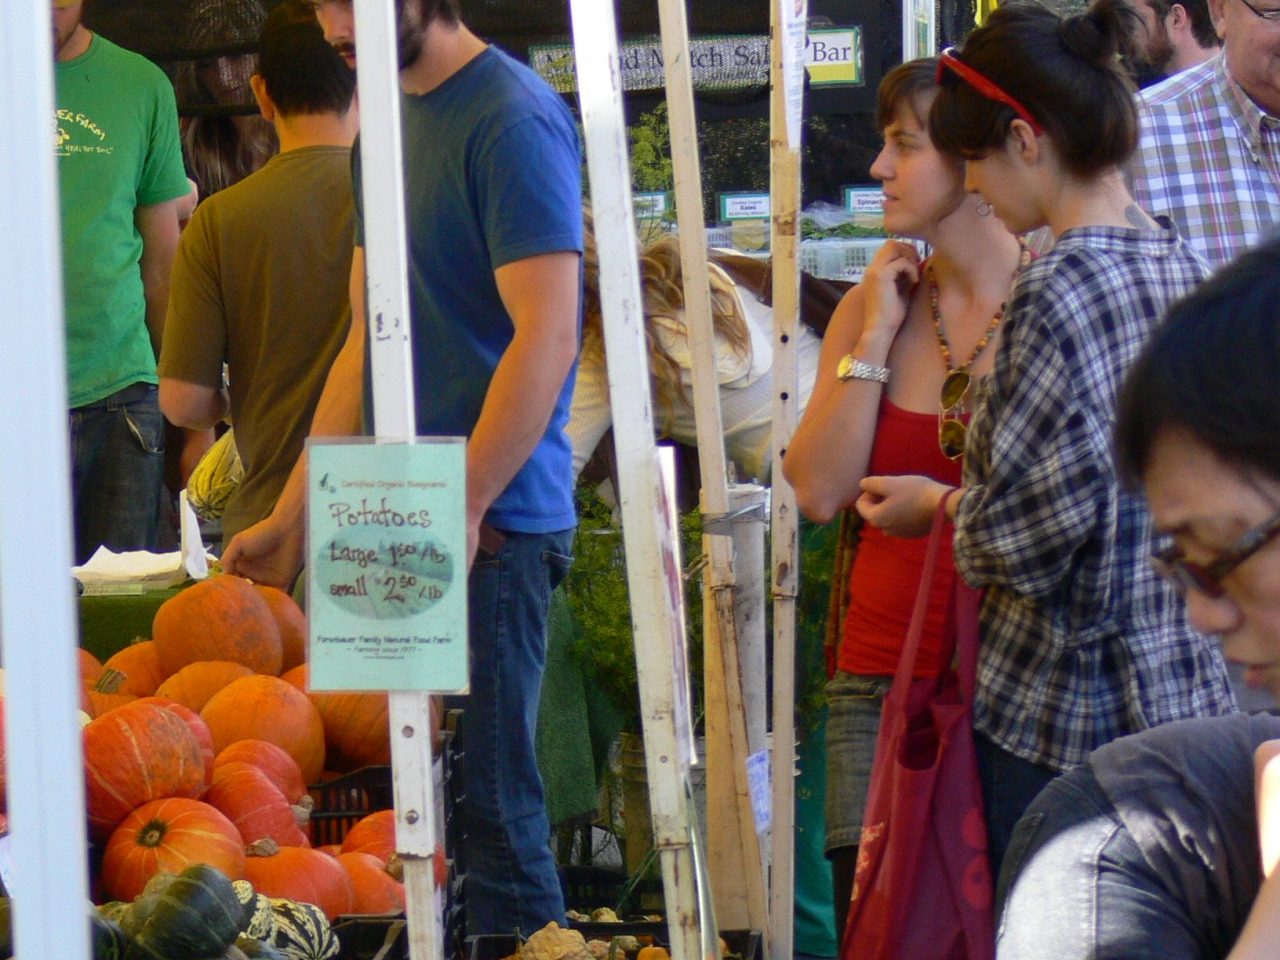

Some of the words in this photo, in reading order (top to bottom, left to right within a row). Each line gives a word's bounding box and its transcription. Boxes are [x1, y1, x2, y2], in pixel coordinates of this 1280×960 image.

[734, 44, 771, 67] Sal
[812, 41, 851, 62] Bar
[328, 497, 432, 528] Potatoes
[329, 541, 378, 568] Large
[330, 574, 368, 597] small
